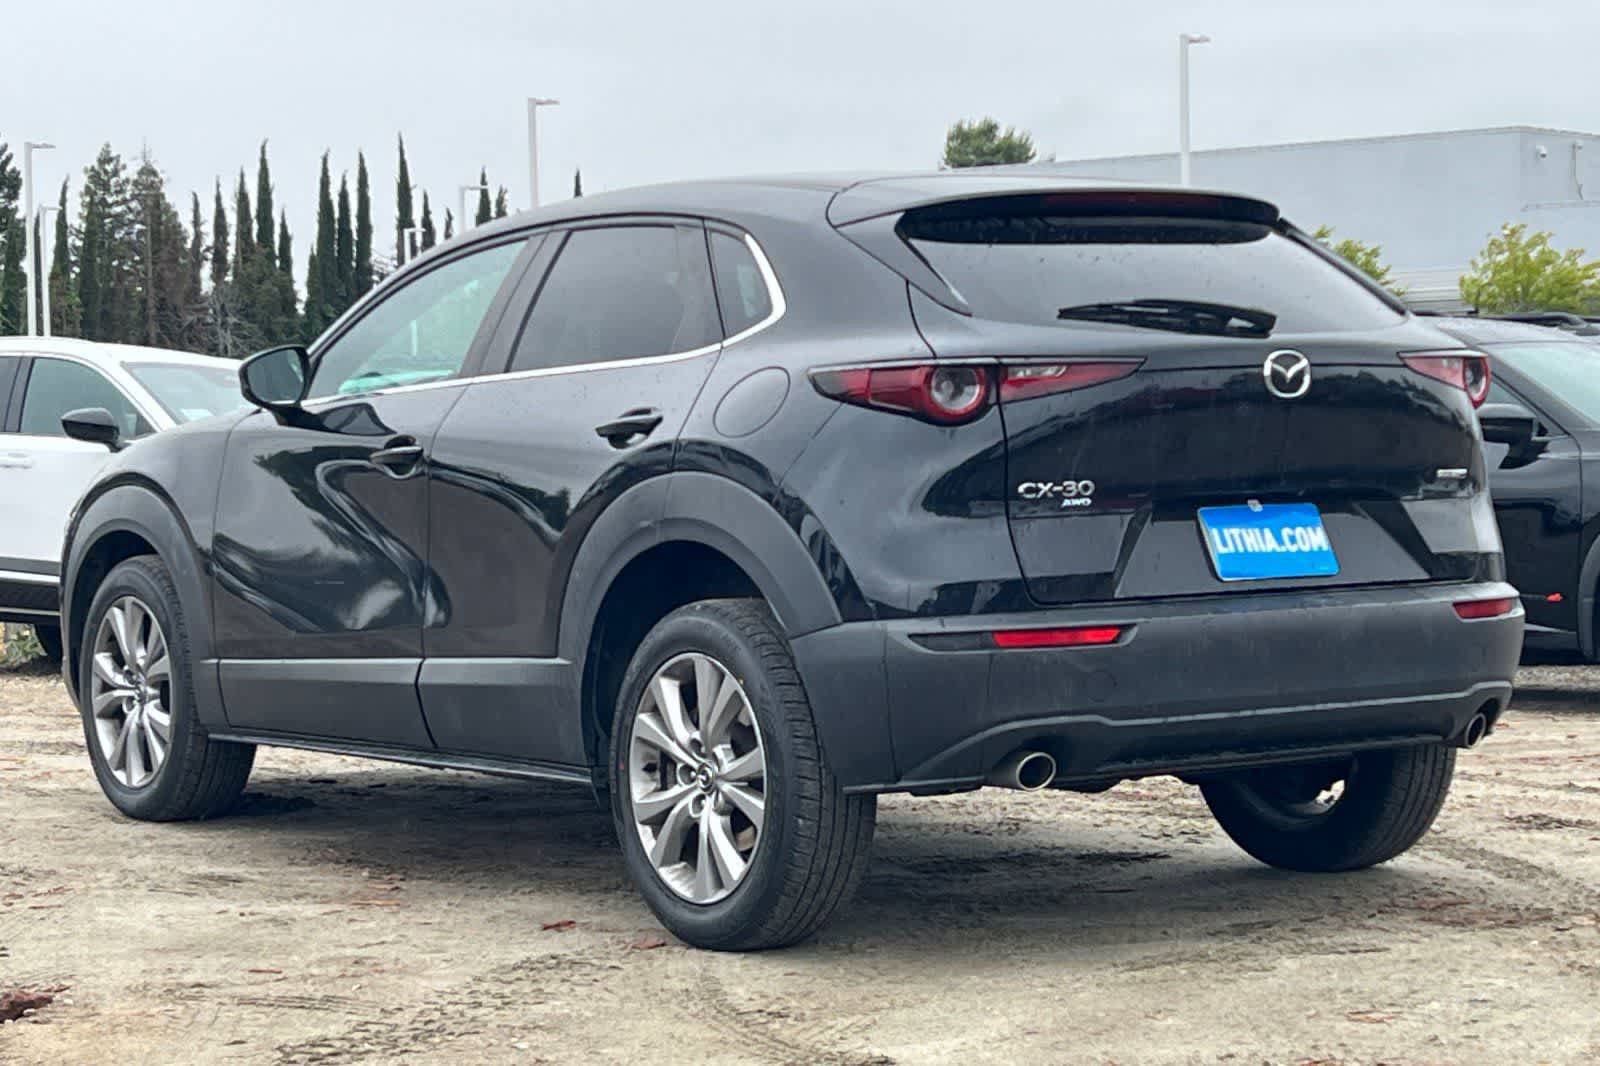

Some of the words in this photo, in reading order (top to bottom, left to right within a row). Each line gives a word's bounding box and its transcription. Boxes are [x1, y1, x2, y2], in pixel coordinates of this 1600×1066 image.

[1017, 480, 1095, 498] CX-30
[1061, 497, 1092, 507] AWD
[1211, 526, 1329, 553] LITHIA.COM
